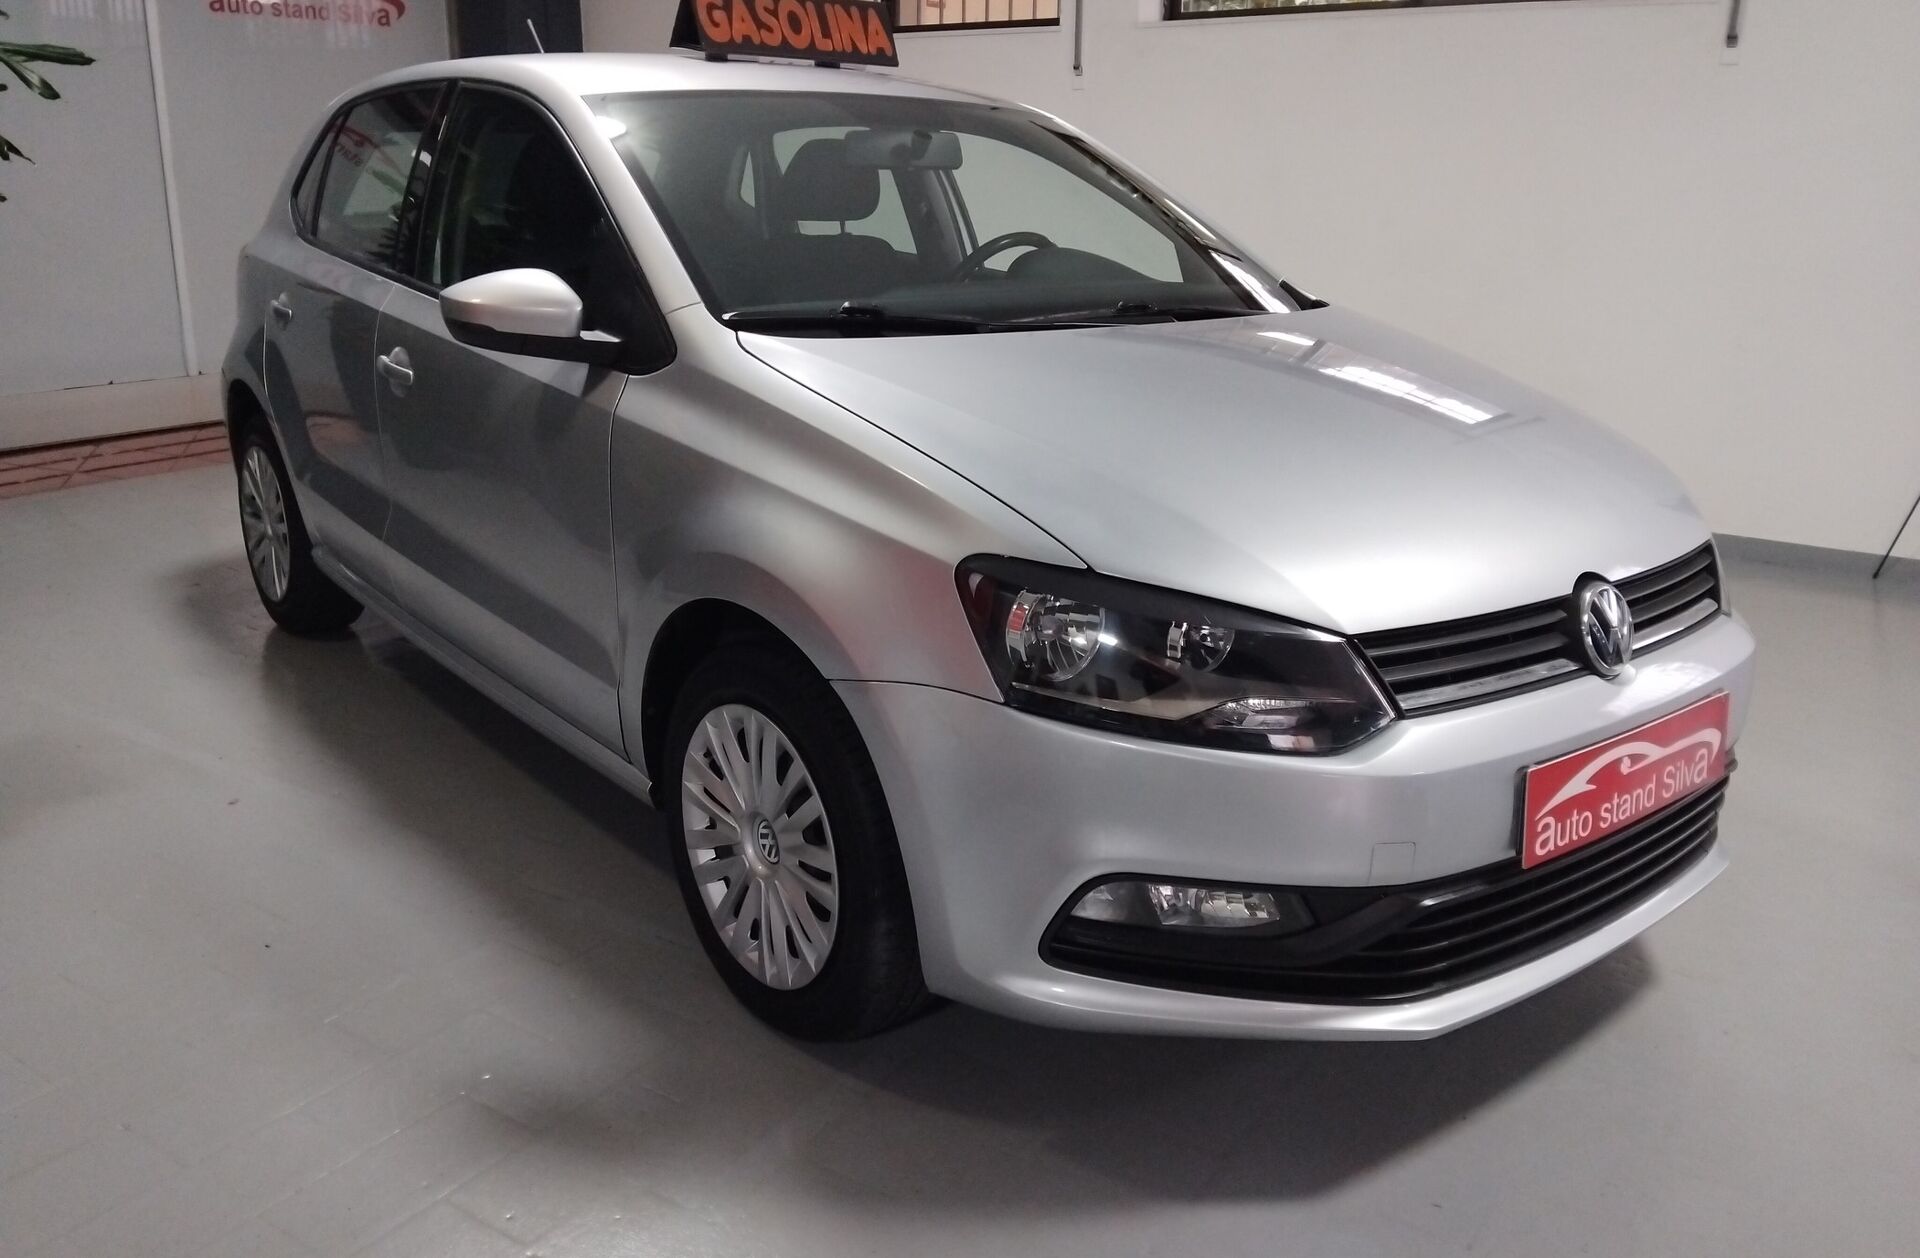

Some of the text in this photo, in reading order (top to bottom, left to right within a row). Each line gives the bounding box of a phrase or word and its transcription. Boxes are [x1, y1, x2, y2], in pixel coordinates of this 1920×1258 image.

[208, 0, 264, 16] auto
[695, 0, 893, 57] GASOLINA
[1535, 748, 1709, 856] auto stand Silva
